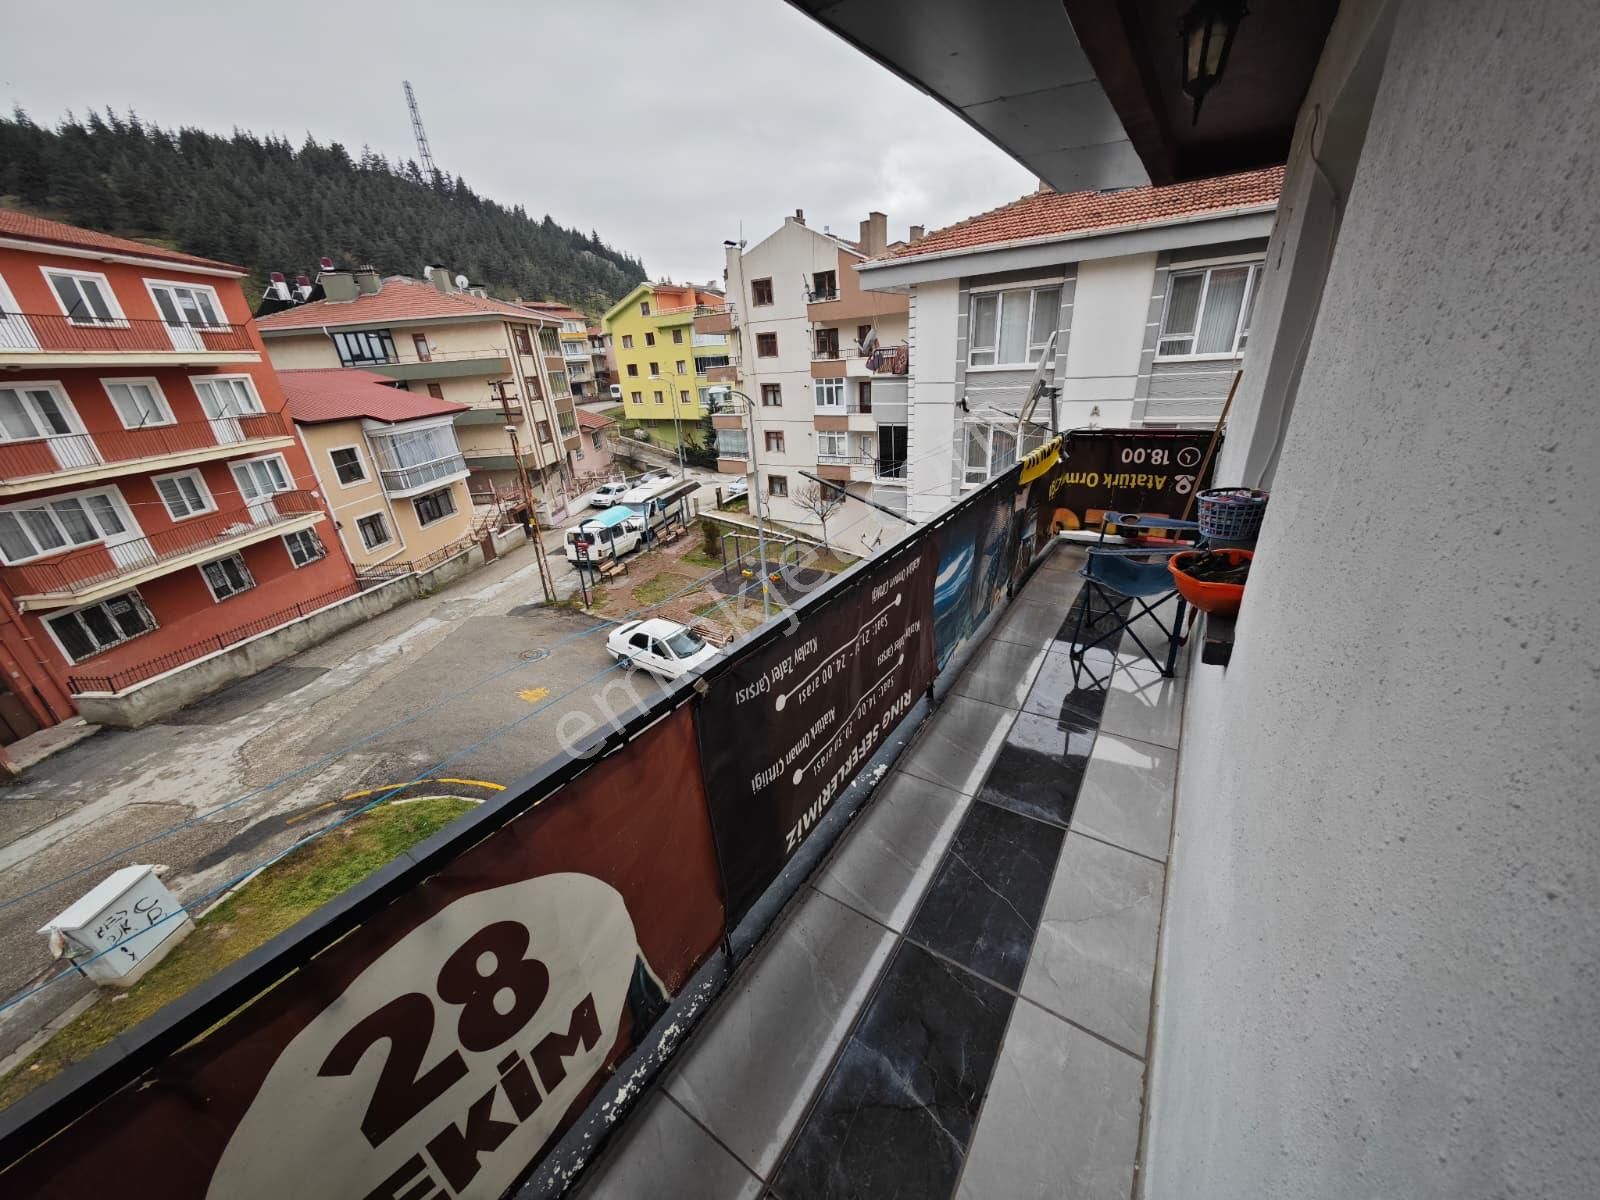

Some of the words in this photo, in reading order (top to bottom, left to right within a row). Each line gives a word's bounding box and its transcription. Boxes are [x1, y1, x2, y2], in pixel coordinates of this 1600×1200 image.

[1121, 448, 1170, 464] 18.00
[1060, 472, 1099, 487] Orm
[1103, 473, 1167, 490] Atatürk
[794, 636, 818, 665] Kızılay
[771, 656, 793, 683] Zafer
[822, 654, 846, 684] 24.00
[736, 672, 770, 705] Çarşısı
[799, 676, 820, 705] arası
[810, 706, 835, 740] Atatürk
[882, 689, 911, 729] RİNG
[786, 732, 810, 765] Orman
[813, 747, 833, 776] arası
[751, 757, 784, 795] Çiftliği
[786, 724, 880, 853] SEFERLERİMİZ
[317, 920, 550, 1149] 28
